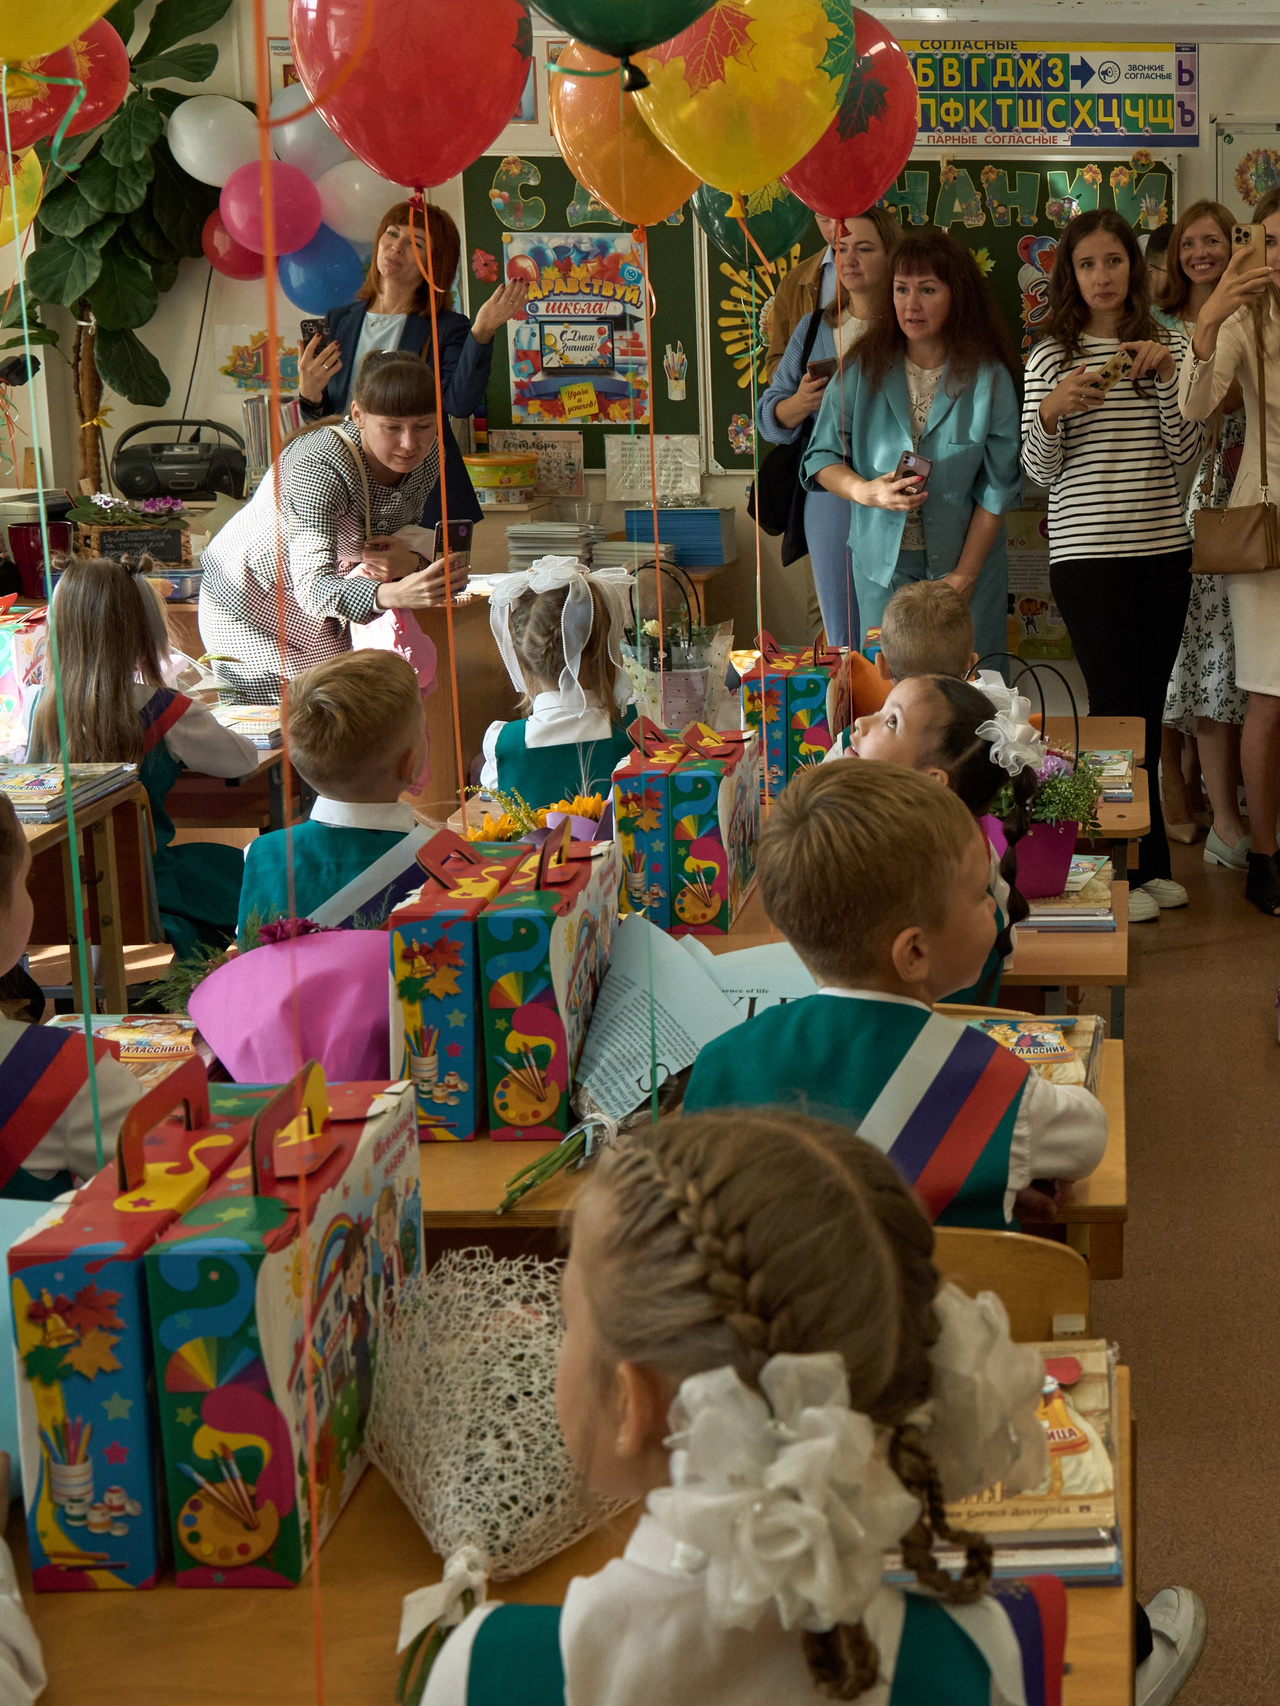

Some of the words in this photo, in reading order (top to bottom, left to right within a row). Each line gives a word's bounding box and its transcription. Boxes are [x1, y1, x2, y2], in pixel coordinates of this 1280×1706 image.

[919, 40, 1018, 50] СОГЛАСНЫЕ
[1127, 64, 1165, 72] ЗВОНКИЕ
[1124, 72, 1173, 81] СОГЛАСНЫЕ
[926, 135, 978, 145] ПАРНЫЕ
[984, 135, 1058, 145] СОГЛАСНЫЕ
[880, 149, 1169, 229] НАНИЙ
[525, 277, 643, 308] ДРАВСТВУЙ,
[119, 1044, 191, 1054] ОКЛАССНИЦА
[1007, 1045, 1067, 1055] КЛАССНИК
